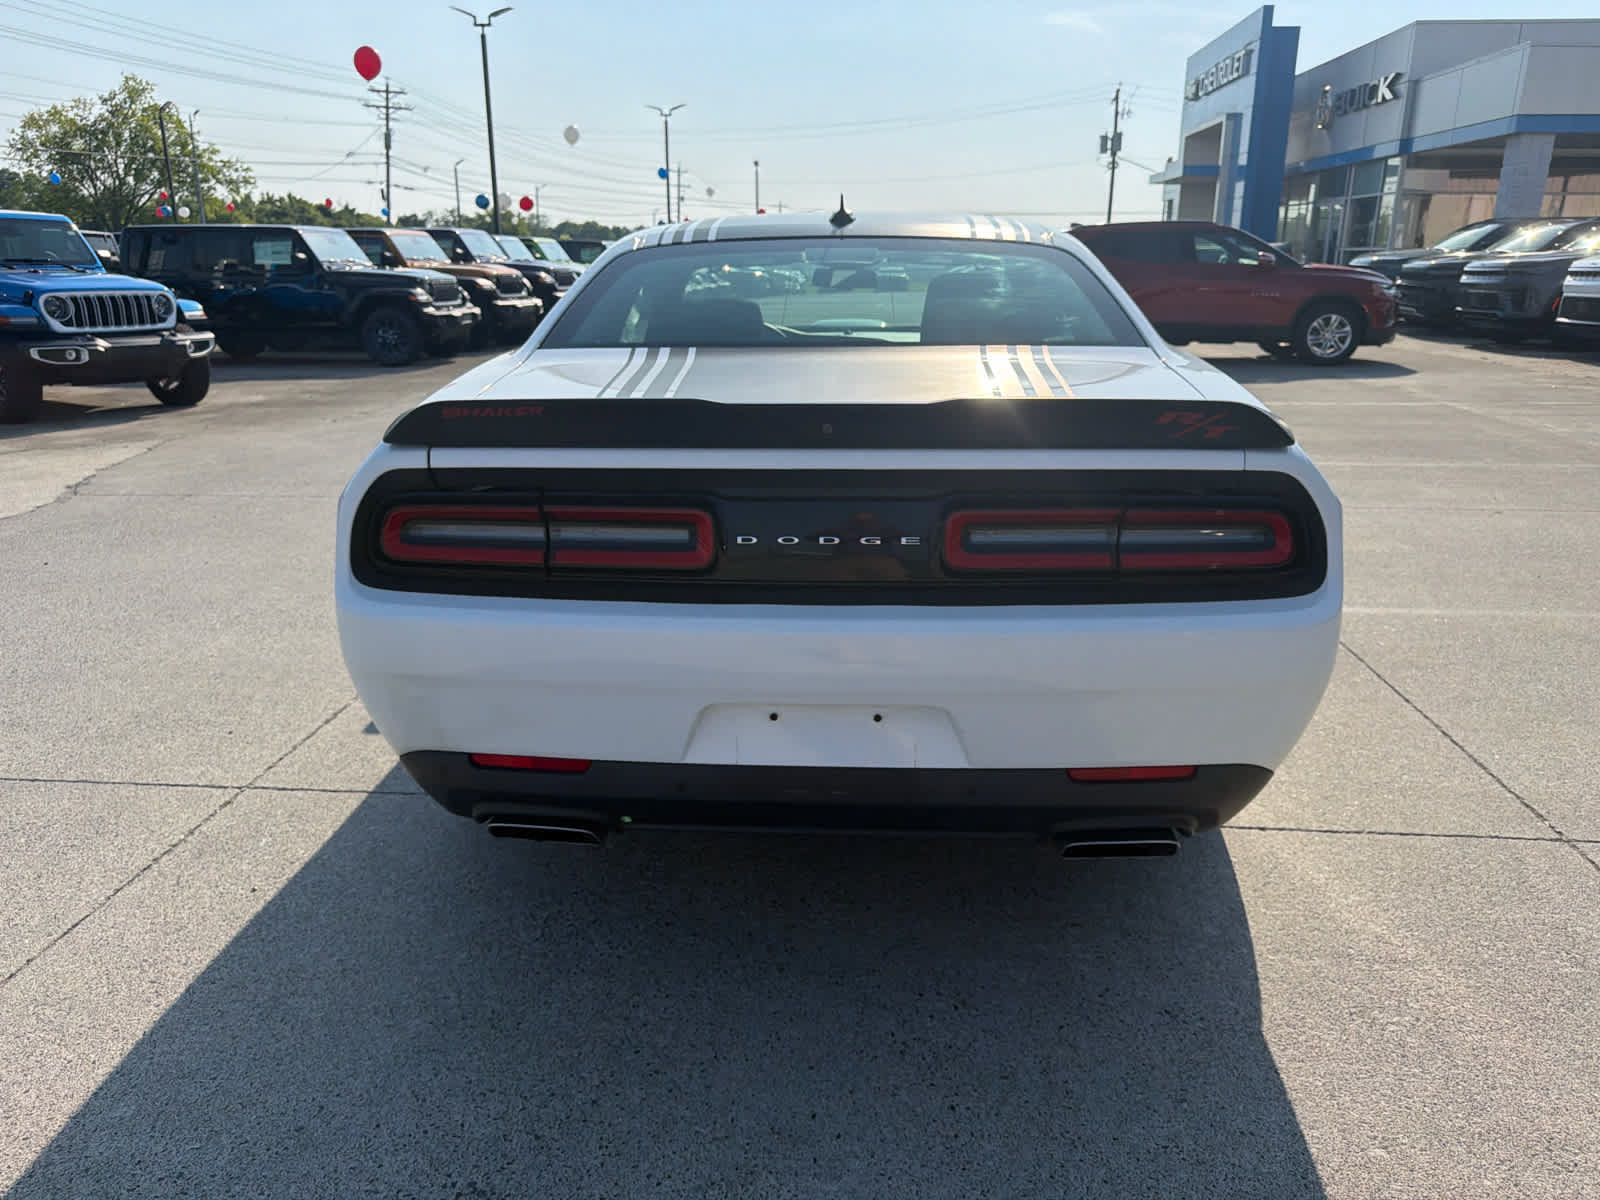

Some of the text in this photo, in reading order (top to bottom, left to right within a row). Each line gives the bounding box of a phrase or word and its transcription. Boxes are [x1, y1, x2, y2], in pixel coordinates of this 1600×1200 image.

[1198, 48, 1250, 96] CHEVROLET
[1335, 73, 1399, 116] BUICK
[441, 405, 544, 418] SHAKER
[1155, 411, 1239, 439] R/T
[736, 535, 921, 545] DODGE
